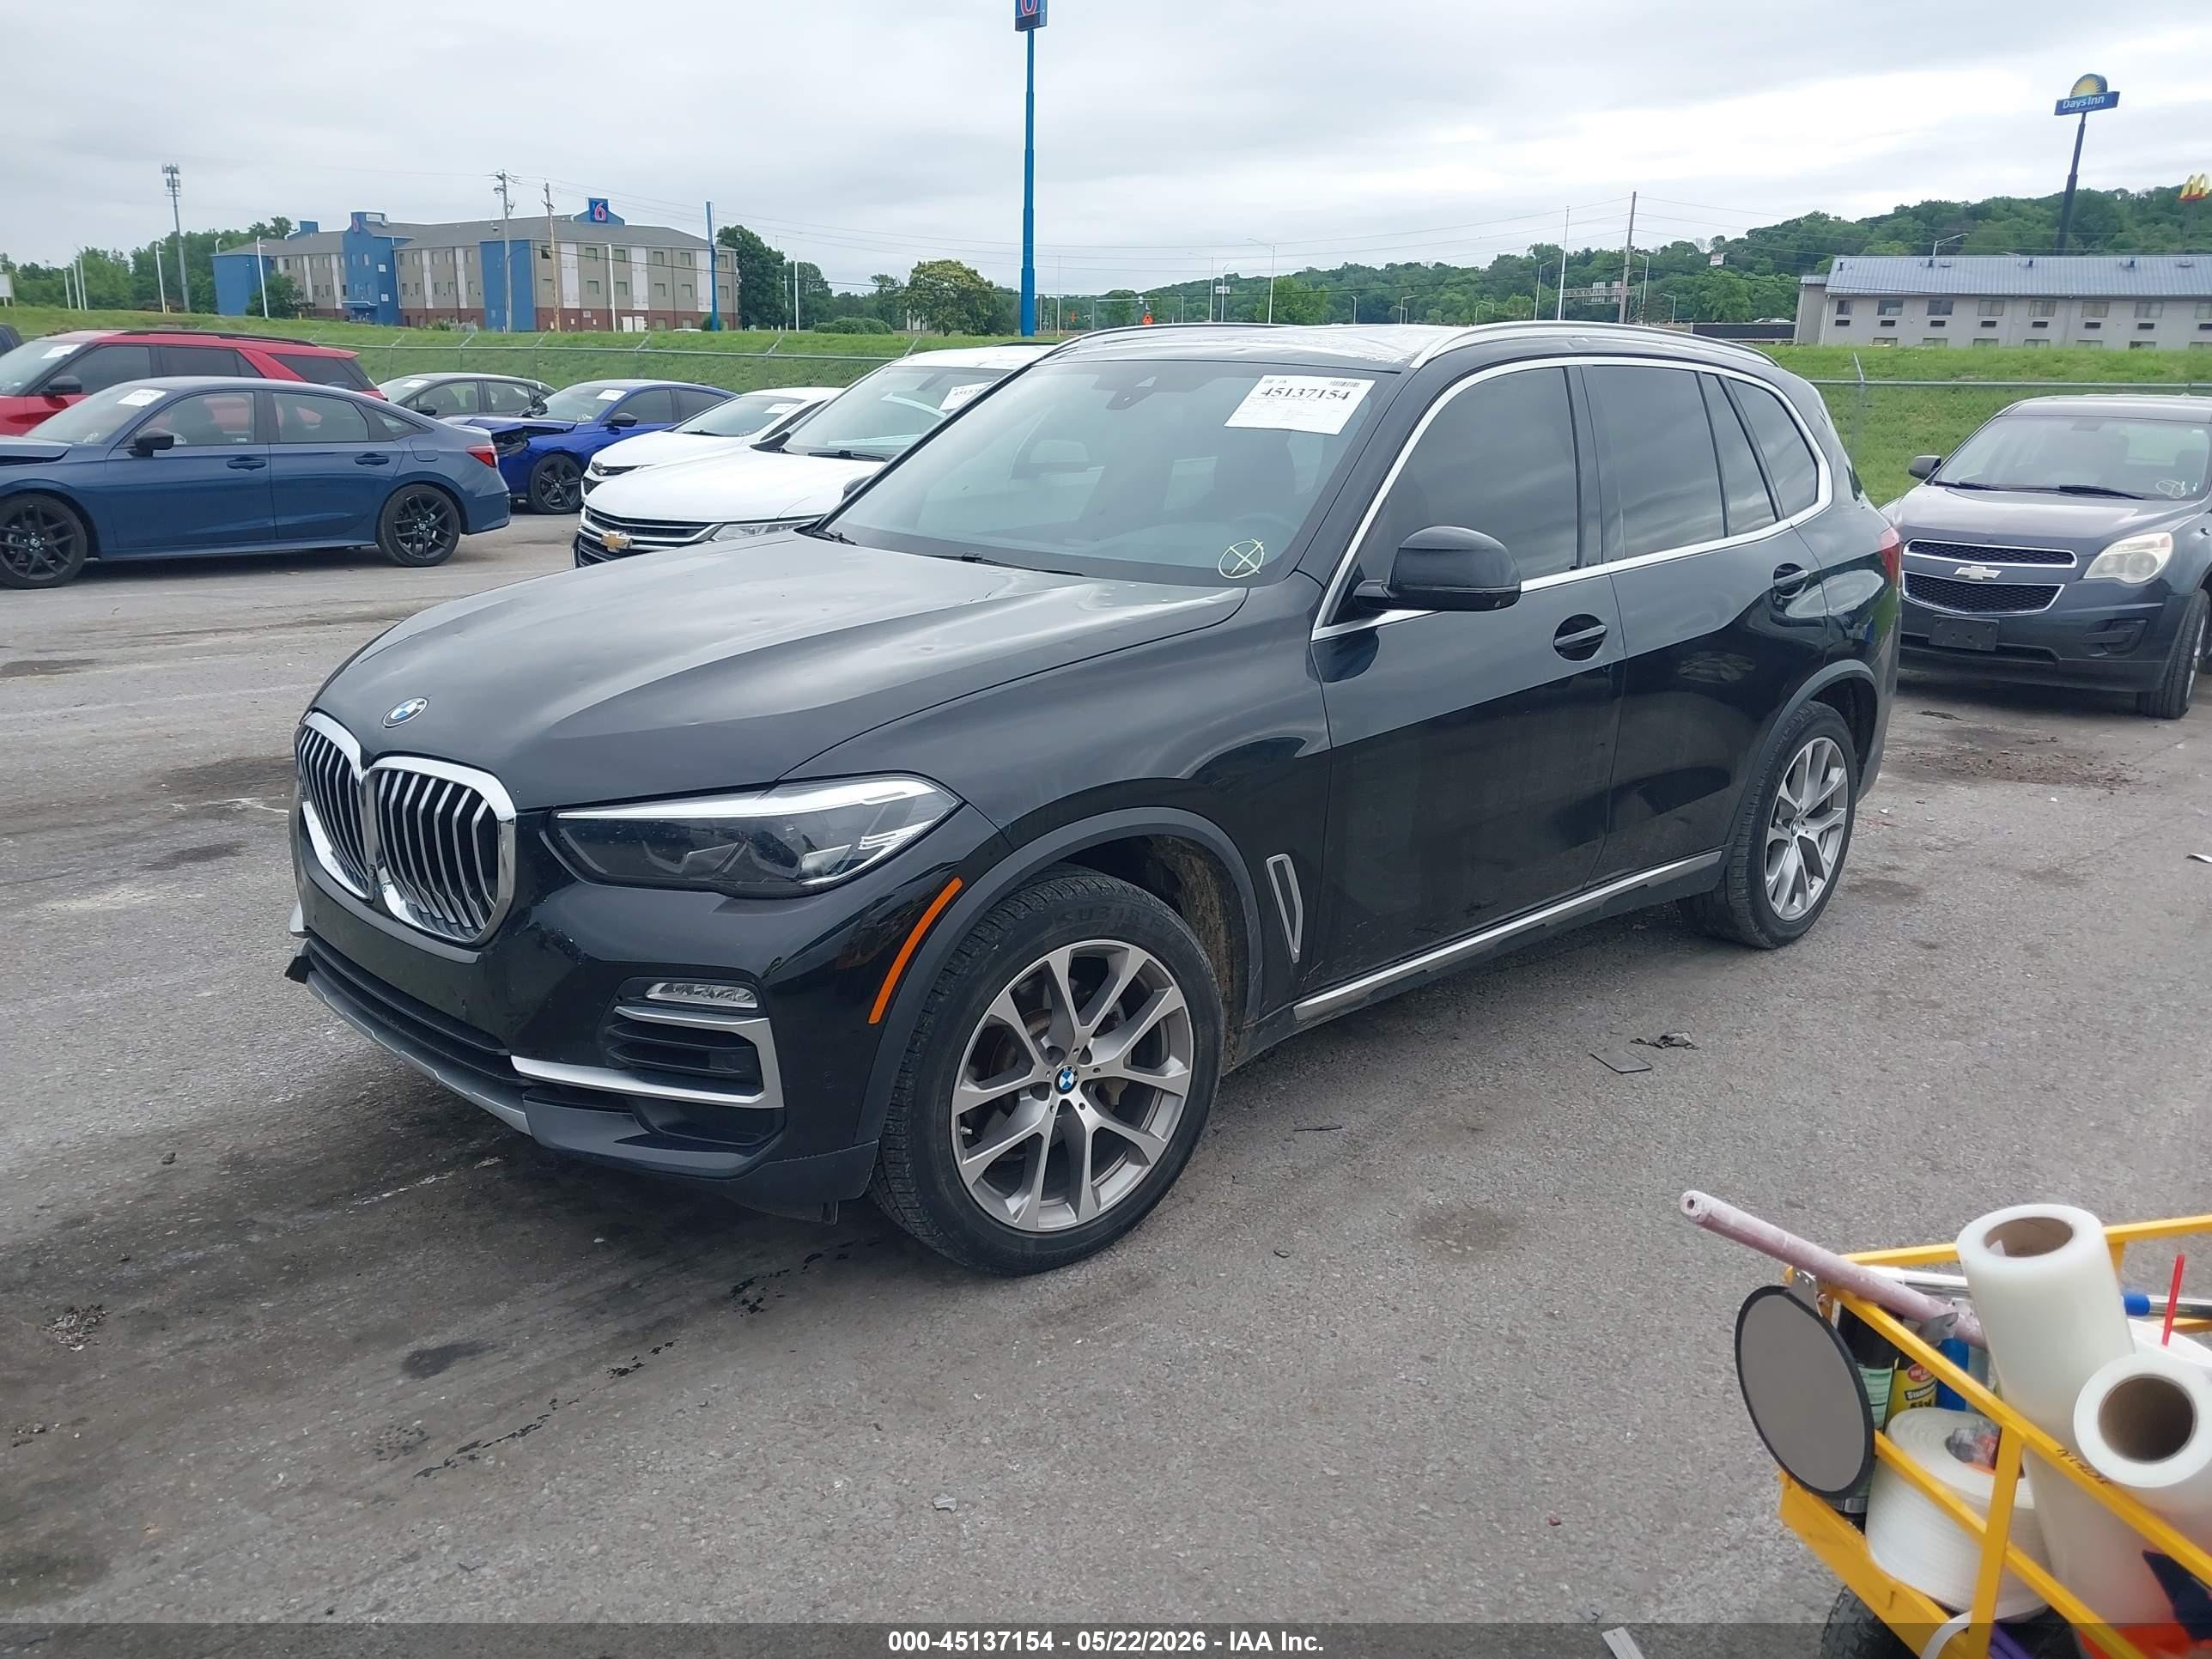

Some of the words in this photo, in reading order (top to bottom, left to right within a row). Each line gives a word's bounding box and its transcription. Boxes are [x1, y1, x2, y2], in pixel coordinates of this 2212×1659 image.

[2063, 99, 2087, 109] Days
[2087, 95, 2105, 106] Inn
[594, 202, 606, 221] 6
[1261, 387, 1351, 400] 45137154
